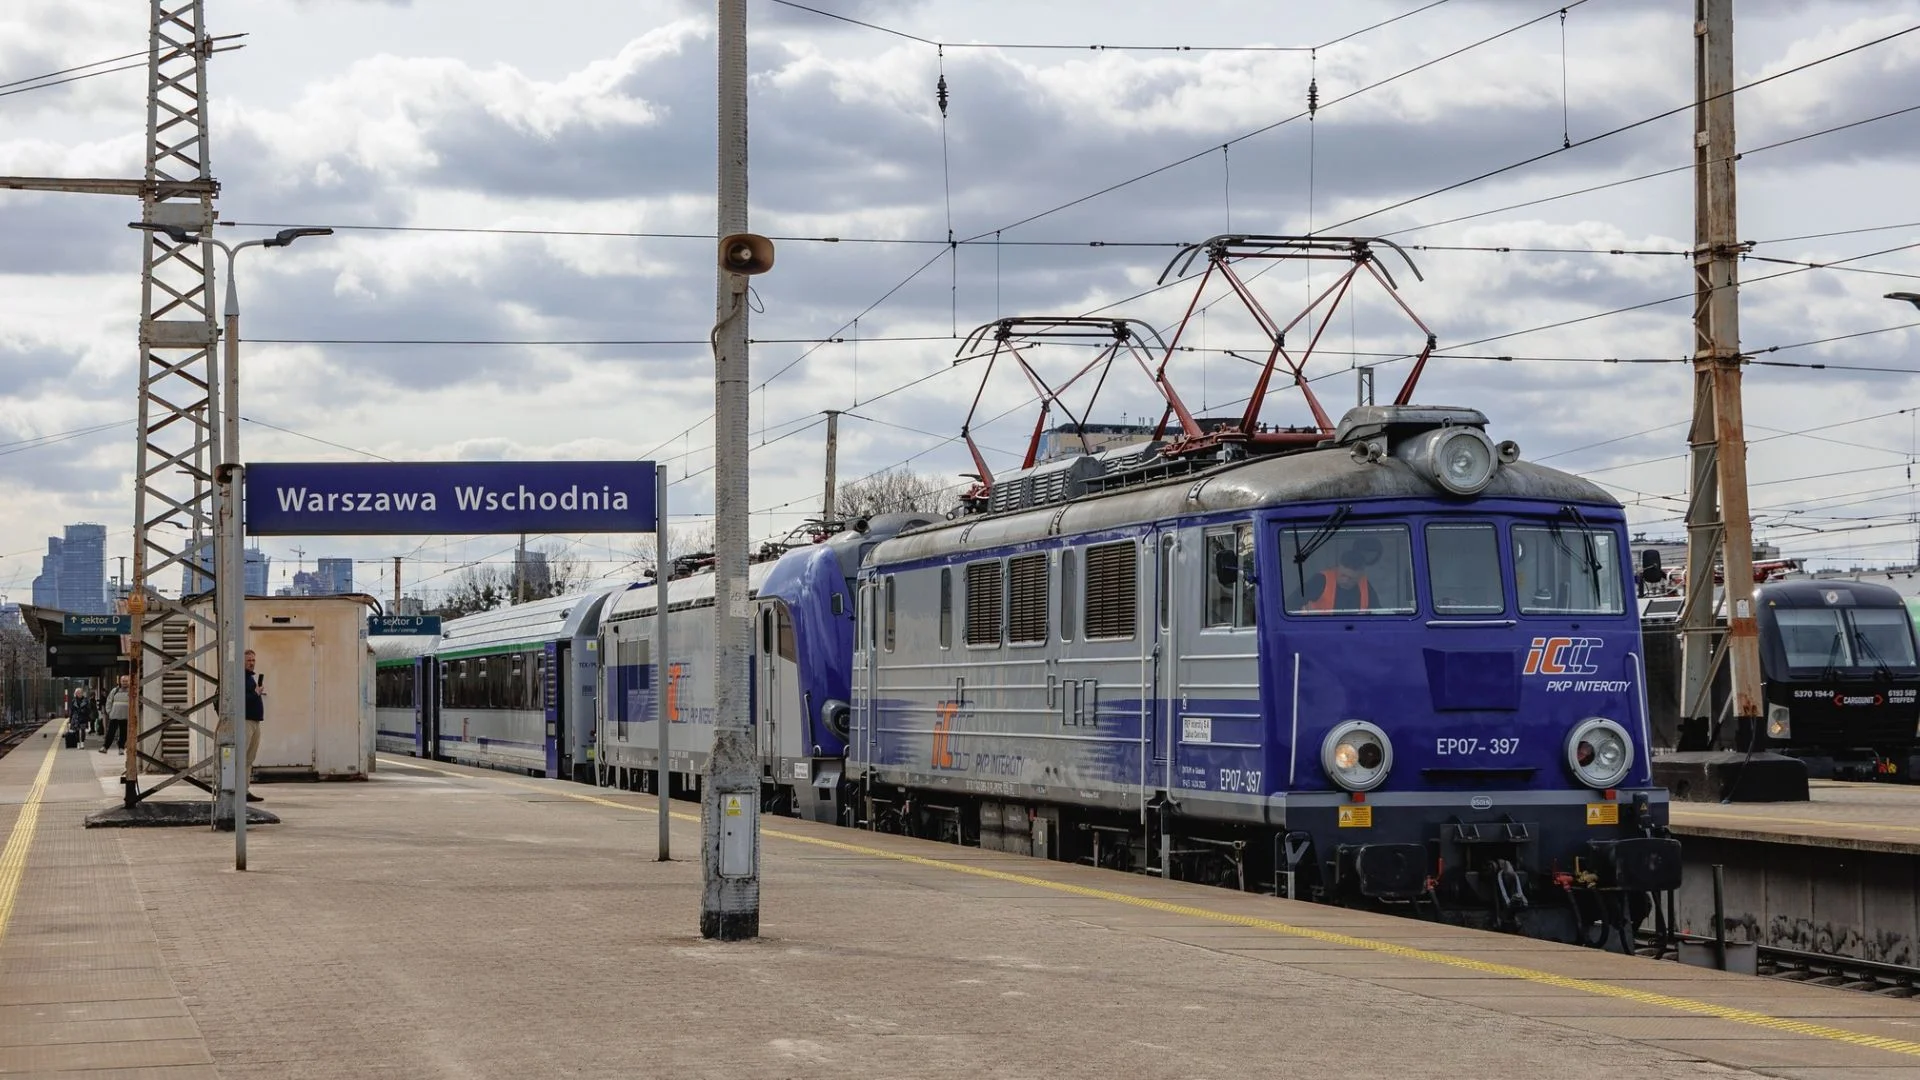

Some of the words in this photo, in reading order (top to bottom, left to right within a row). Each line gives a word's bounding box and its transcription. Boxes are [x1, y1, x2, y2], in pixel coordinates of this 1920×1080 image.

[277, 487, 436, 511] Warszawa
[455, 485, 628, 510] Wschodnia
[81, 616, 108, 624] sektor
[112, 616, 120, 624] D
[383, 616, 410, 625] sektor
[416, 617, 423, 625] D
[1546, 680, 1572, 692] PKP
[1574, 680, 1631, 692] INTERCITY
[1794, 690, 1813, 698] 5370
[976, 753, 990, 773] PKP
[991, 753, 1025, 777] INTERCITY
